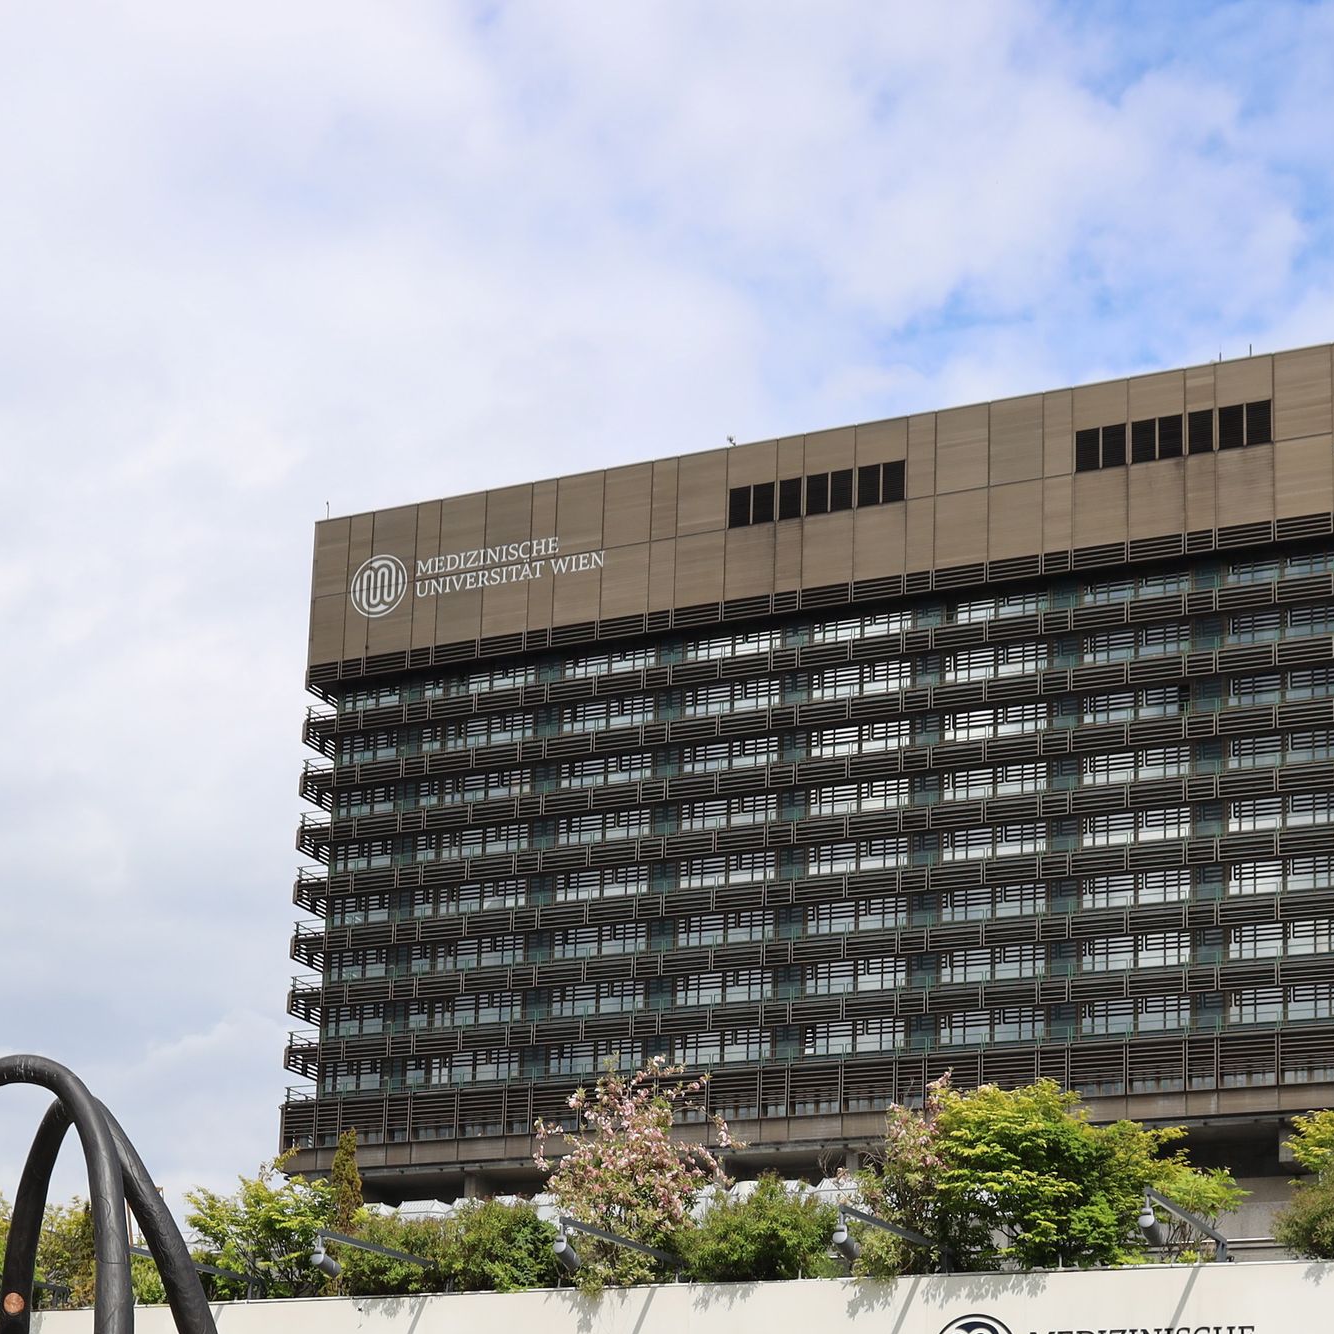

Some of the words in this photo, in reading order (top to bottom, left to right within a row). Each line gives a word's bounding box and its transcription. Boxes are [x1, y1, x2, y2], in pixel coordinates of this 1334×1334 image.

[415, 536, 559, 577] MEDIZINISCHE
[415, 555, 546, 598] UNIVERSITÄT
[549, 550, 606, 575] WIEN
